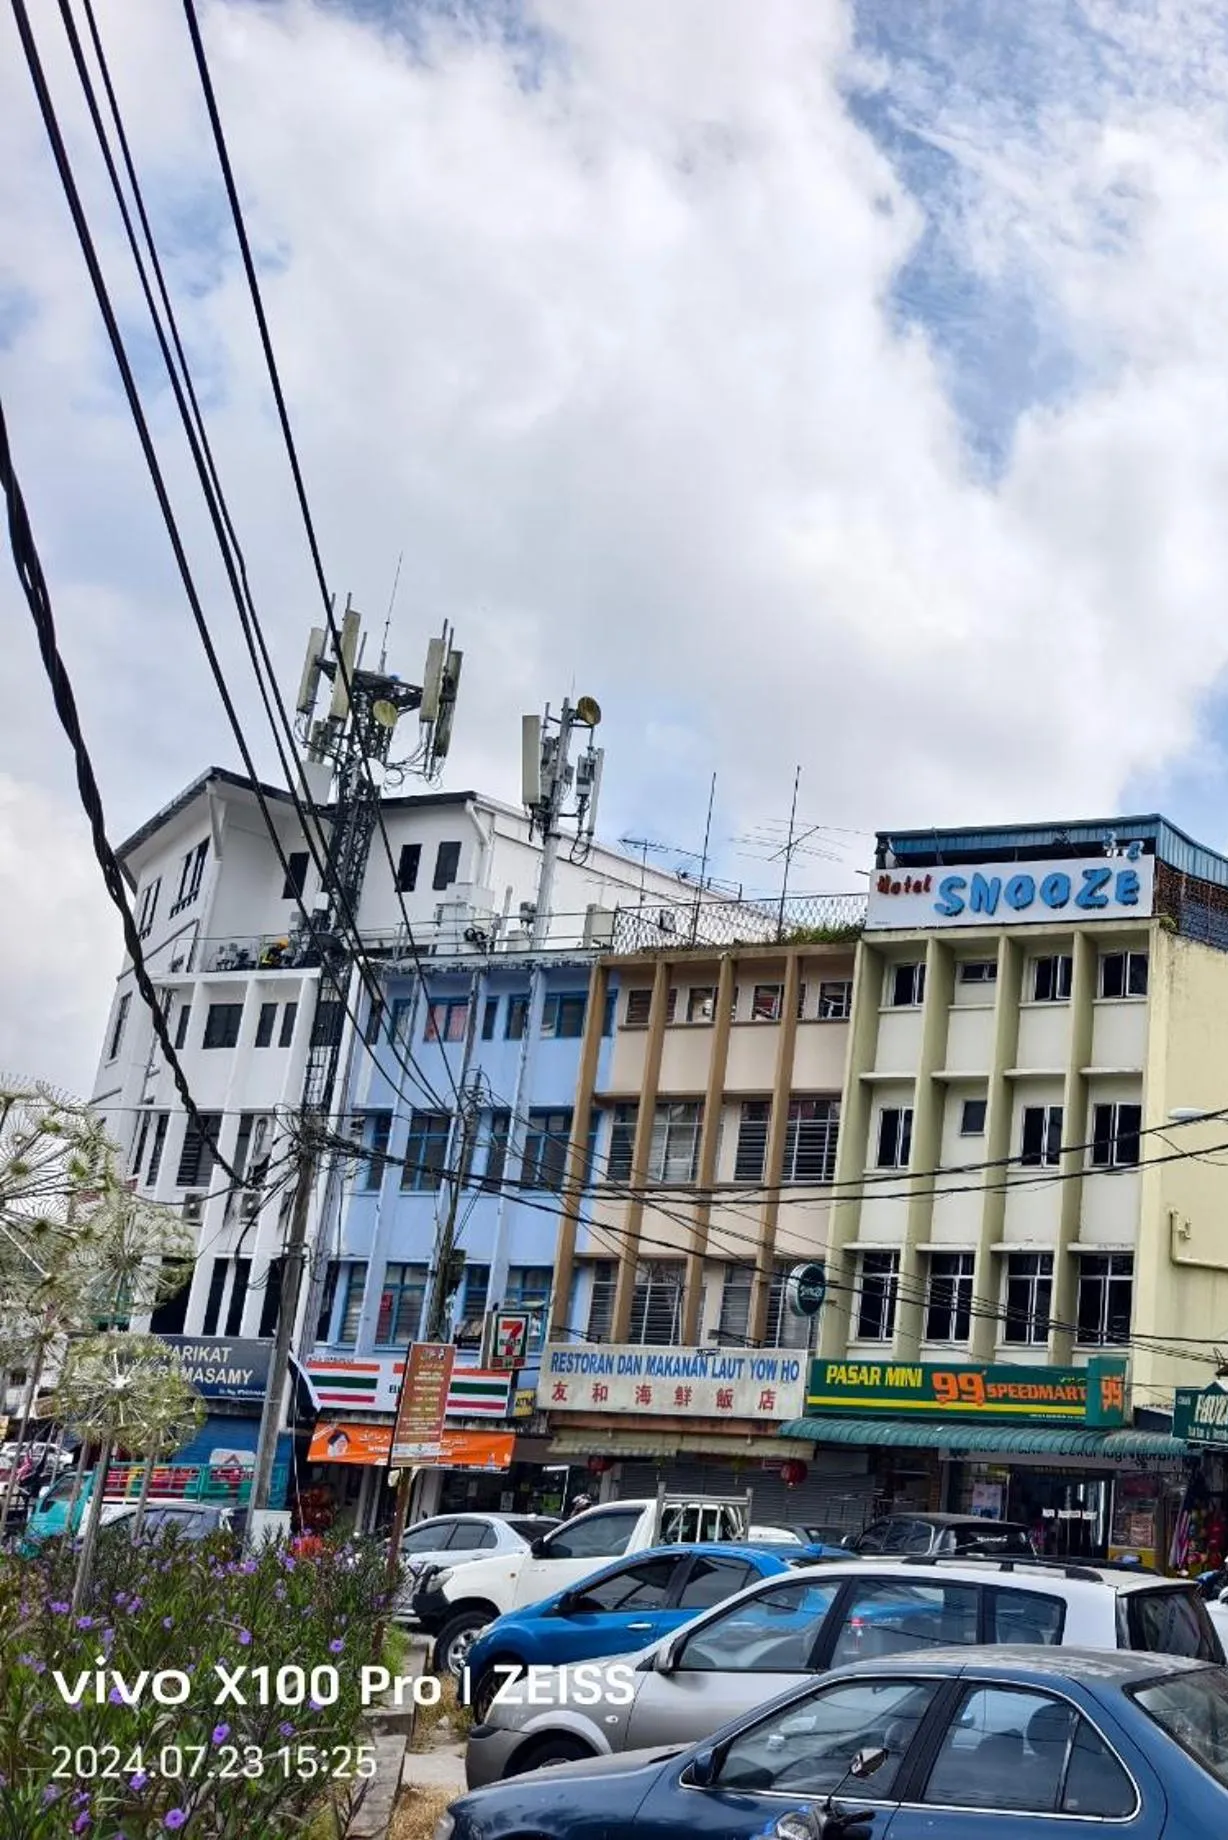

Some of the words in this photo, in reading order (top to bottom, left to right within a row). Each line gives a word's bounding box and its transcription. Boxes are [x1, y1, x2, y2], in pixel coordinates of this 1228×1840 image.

[877, 873, 933, 896] Hotel
[934, 867, 1141, 917] SNOOZE
[157, 1364, 253, 1386] RMASAMY
[551, 1352, 614, 1375] RESTORAN
[617, 1354, 643, 1376] DAN
[646, 1355, 709, 1379] MAKANAN
[712, 1357, 745, 1380] LAUT
[750, 1359, 778, 1381] YOW
[781, 1360, 800, 1382] HO
[826, 1365, 881, 1386] PASAR
[885, 1367, 923, 1389] MINI
[932, 1371, 985, 1408] 99
[987, 1383, 1087, 1401] SPEEDMART
